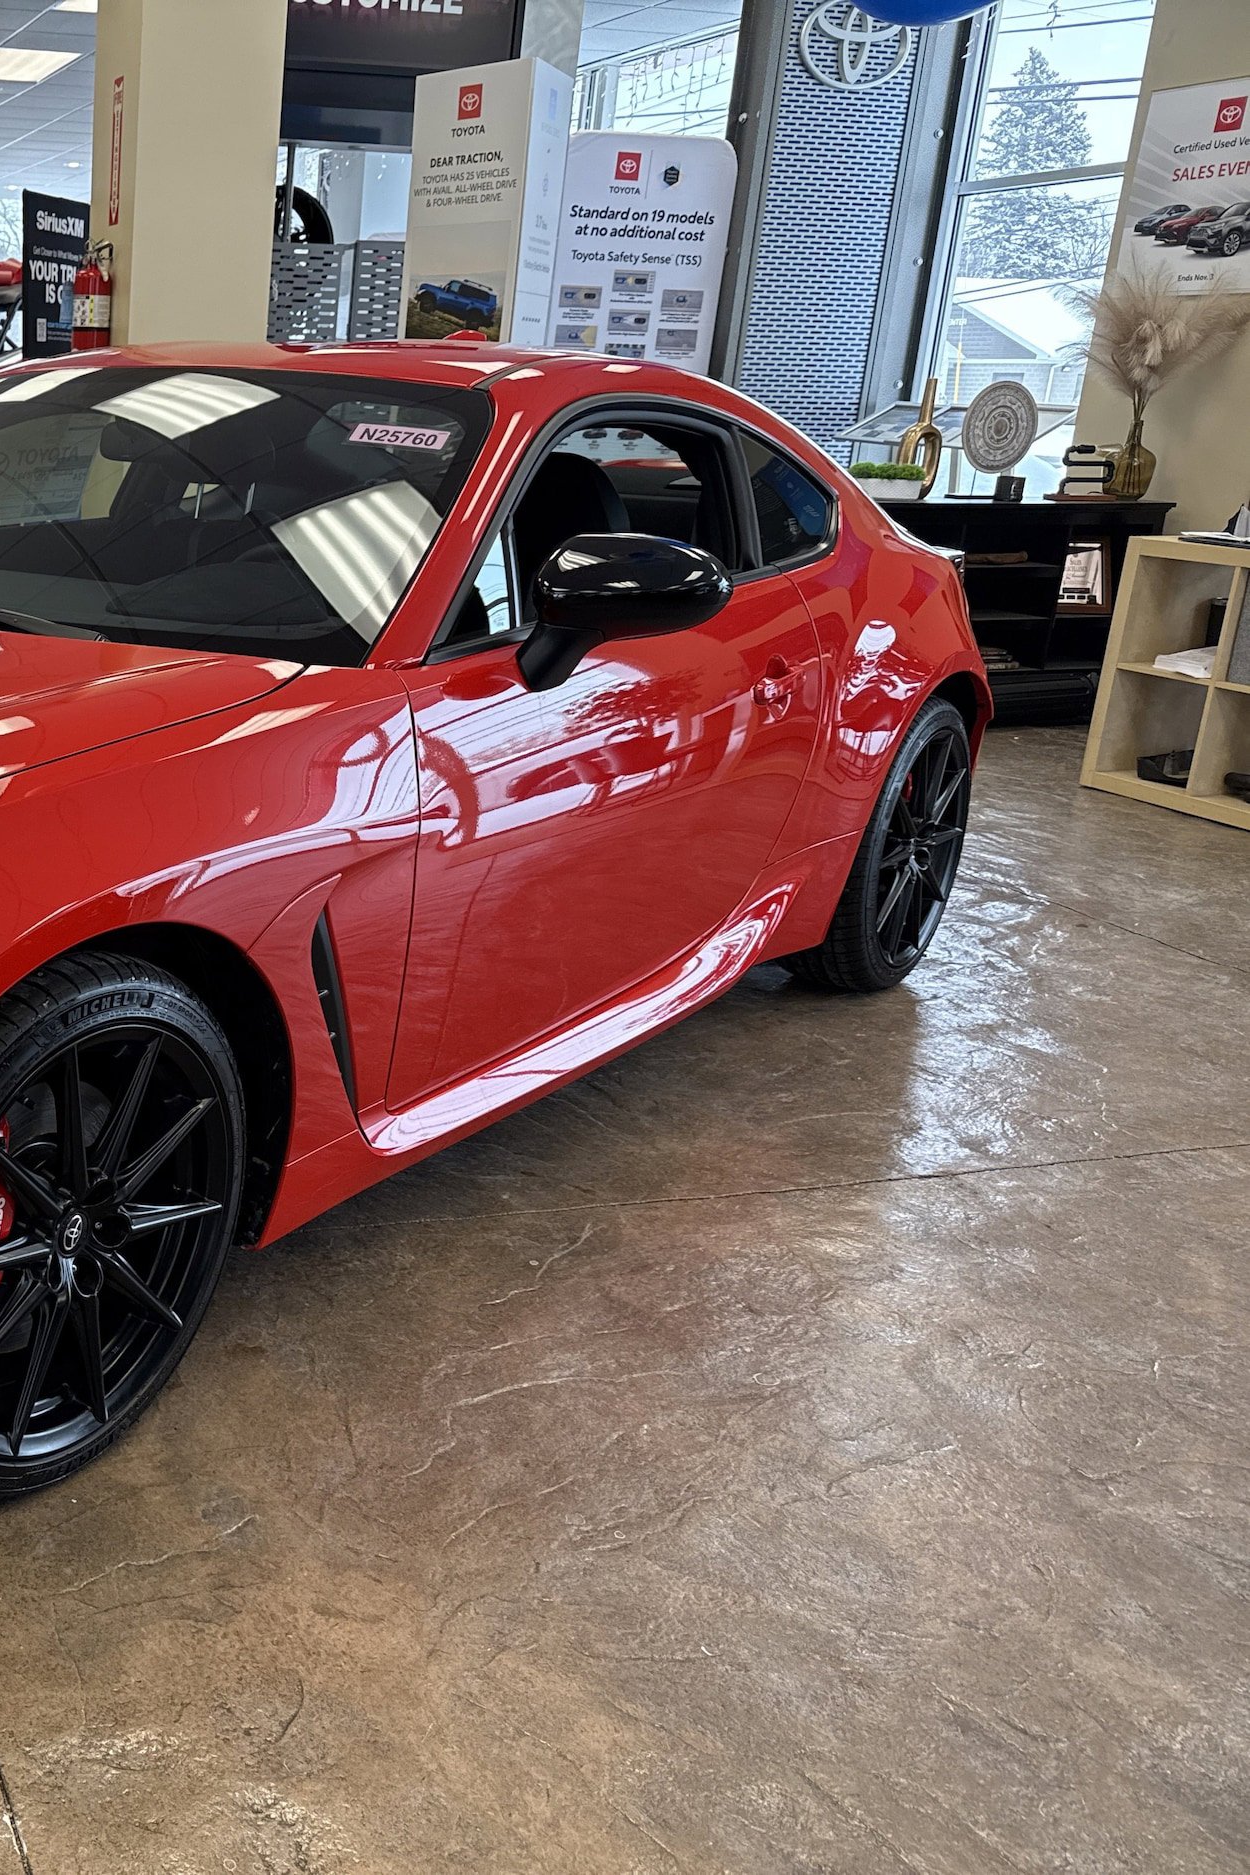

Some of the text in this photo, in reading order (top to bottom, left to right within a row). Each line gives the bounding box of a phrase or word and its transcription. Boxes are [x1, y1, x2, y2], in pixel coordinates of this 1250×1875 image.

[451, 124, 486, 138] TOYOTA
[1173, 139, 1213, 154] Certified
[1213, 137, 1238, 149] Used
[430, 151, 504, 169] DEAR TRACTION,
[422, 168, 510, 185] TOYOTA HAS 25 VEHICLES
[1172, 164, 1216, 182] SALES
[413, 187, 431, 198] WITH
[454, 181, 494, 194] ALL-WHEEL
[495, 178, 518, 189] DRIVE
[608, 185, 641, 195] TOYOTA
[432, 195, 479, 208] FOUR-WHEEL
[569, 204, 715, 225] Standard on 19 models
[36, 209, 85, 239] SiriusXM
[574, 224, 706, 242] at no additional cost
[571, 249, 606, 263] Toyota
[607, 250, 640, 265] Safety
[675, 253, 703, 268] (TSS)
[29, 259, 77, 284] YOUR TRI
[1178, 273, 1193, 282] Ends
[45, 283, 56, 304] IS
[359, 427, 438, 447] N25760
